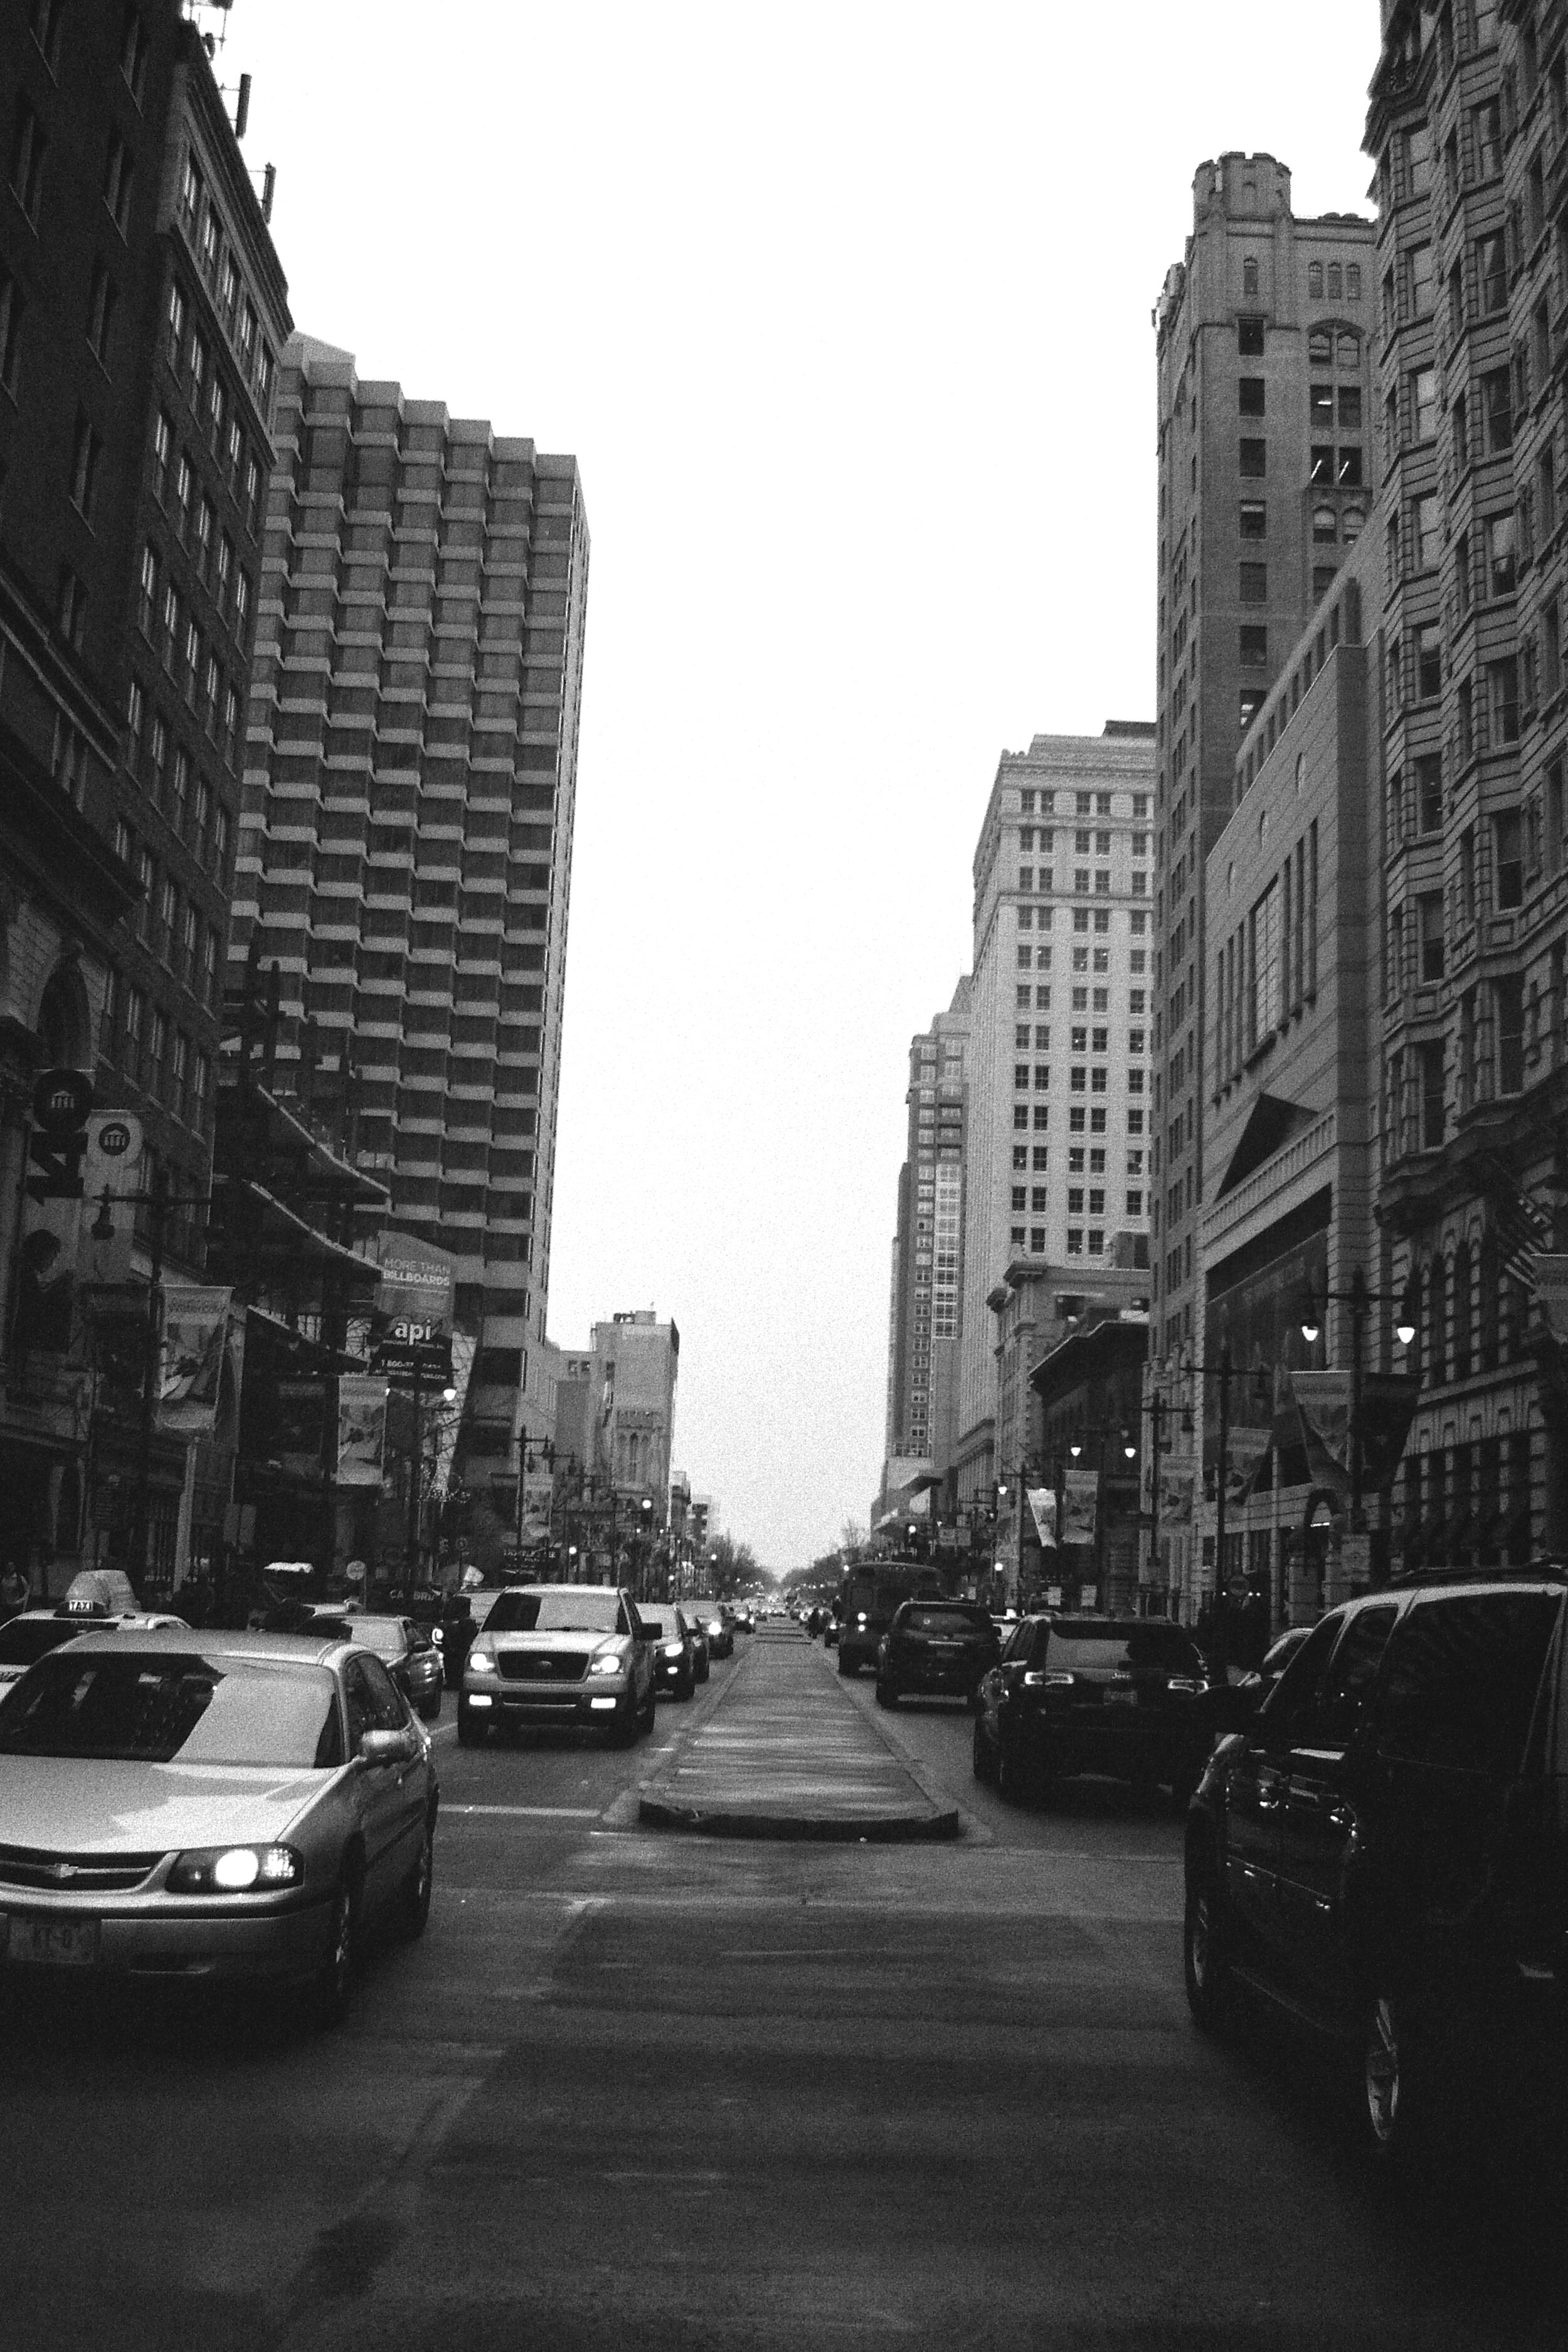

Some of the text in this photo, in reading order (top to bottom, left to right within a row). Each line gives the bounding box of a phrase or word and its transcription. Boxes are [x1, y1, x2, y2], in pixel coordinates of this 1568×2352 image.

[384, 1258, 451, 1274] MORE THAN
[383, 1269, 450, 1286] BILLBOARDS
[395, 1319, 432, 1346] api
[70, 1601, 92, 1611] TAXI
